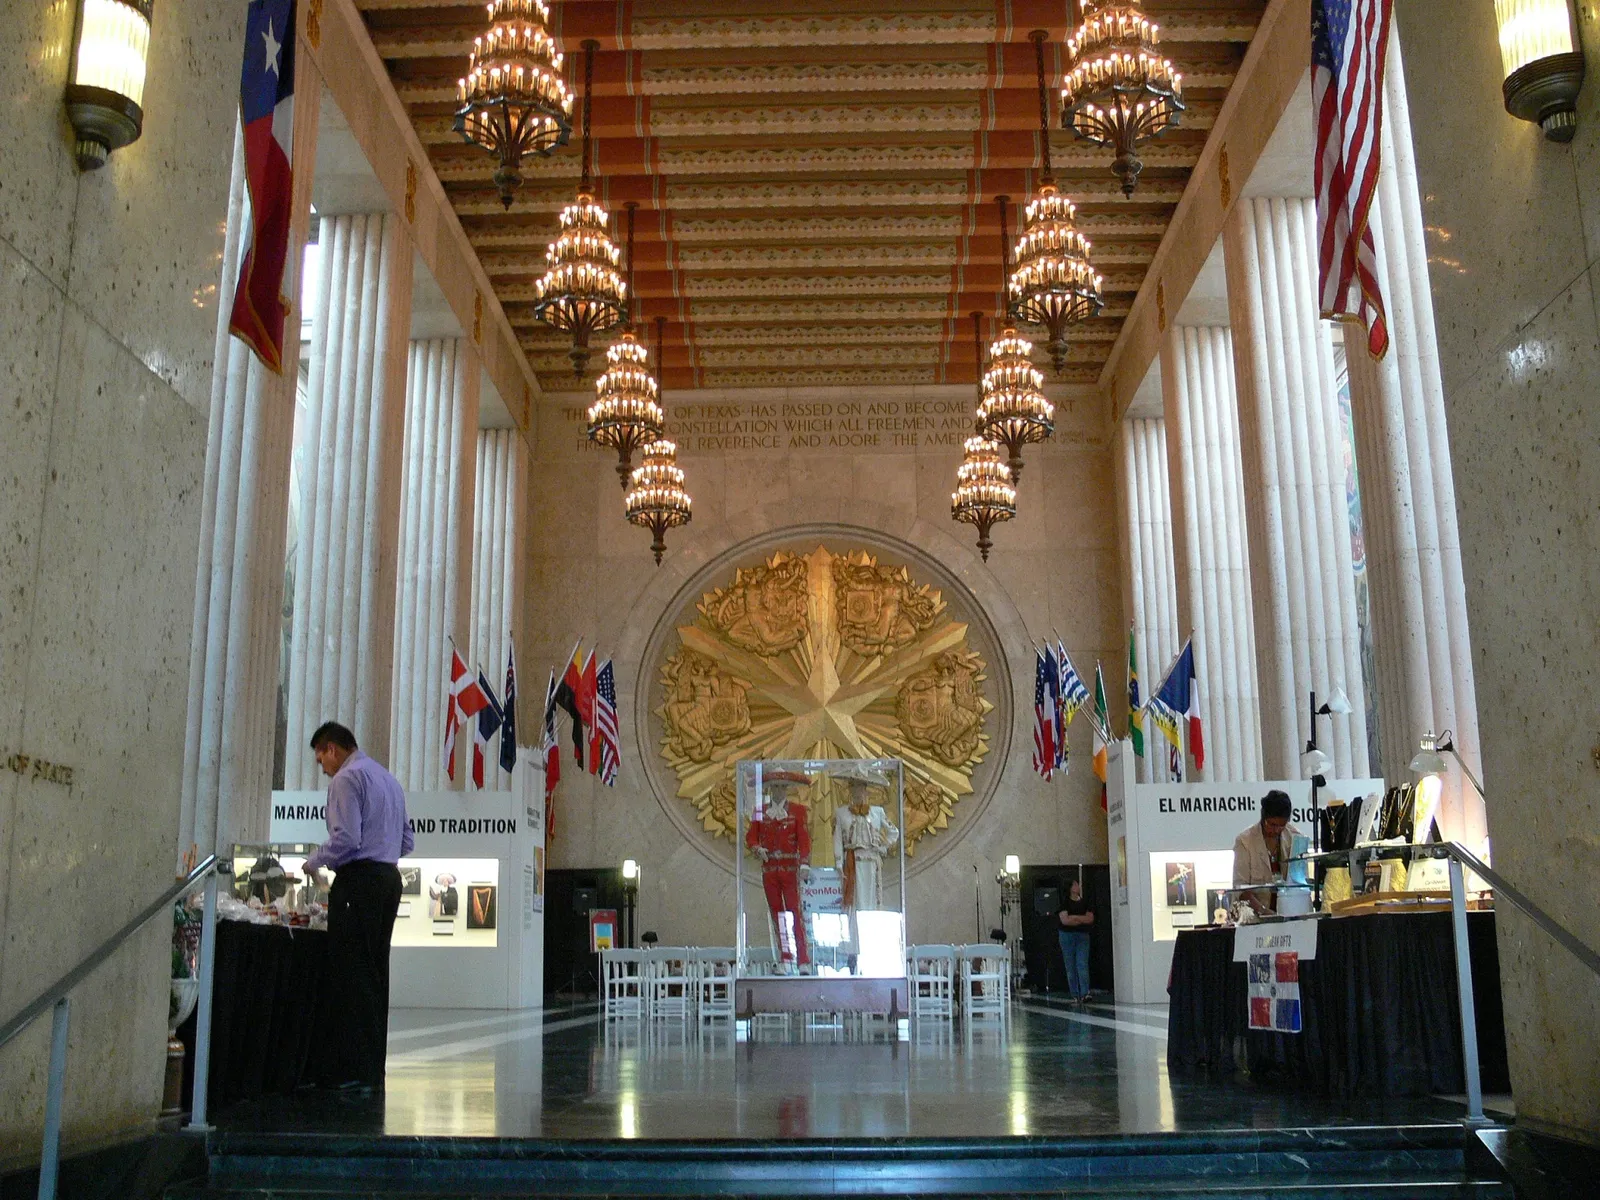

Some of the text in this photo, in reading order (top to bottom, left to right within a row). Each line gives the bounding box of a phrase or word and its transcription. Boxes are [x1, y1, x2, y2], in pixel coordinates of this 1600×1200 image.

[674, 406, 694, 420] OF
[697, 405, 741, 418] TEXAS
[751, 404, 777, 417] HAS
[782, 403, 833, 417] PASSED
[837, 402, 861, 416] ON
[867, 402, 899, 415] AND
[905, 401, 969, 414] BECOME
[668, 416, 973, 436] ONSTELLATION WHICH ALL FREEMEN AND
[698, 434, 781, 450] REVERENCE
[788, 435, 820, 448] AND
[829, 433, 881, 448] ADORE
[893, 432, 918, 446] THE
[274, 805, 327, 820] MARIAC
[1159, 796, 1256, 813] EL MARIACHI:
[409, 818, 516, 834] AND TRADITION
